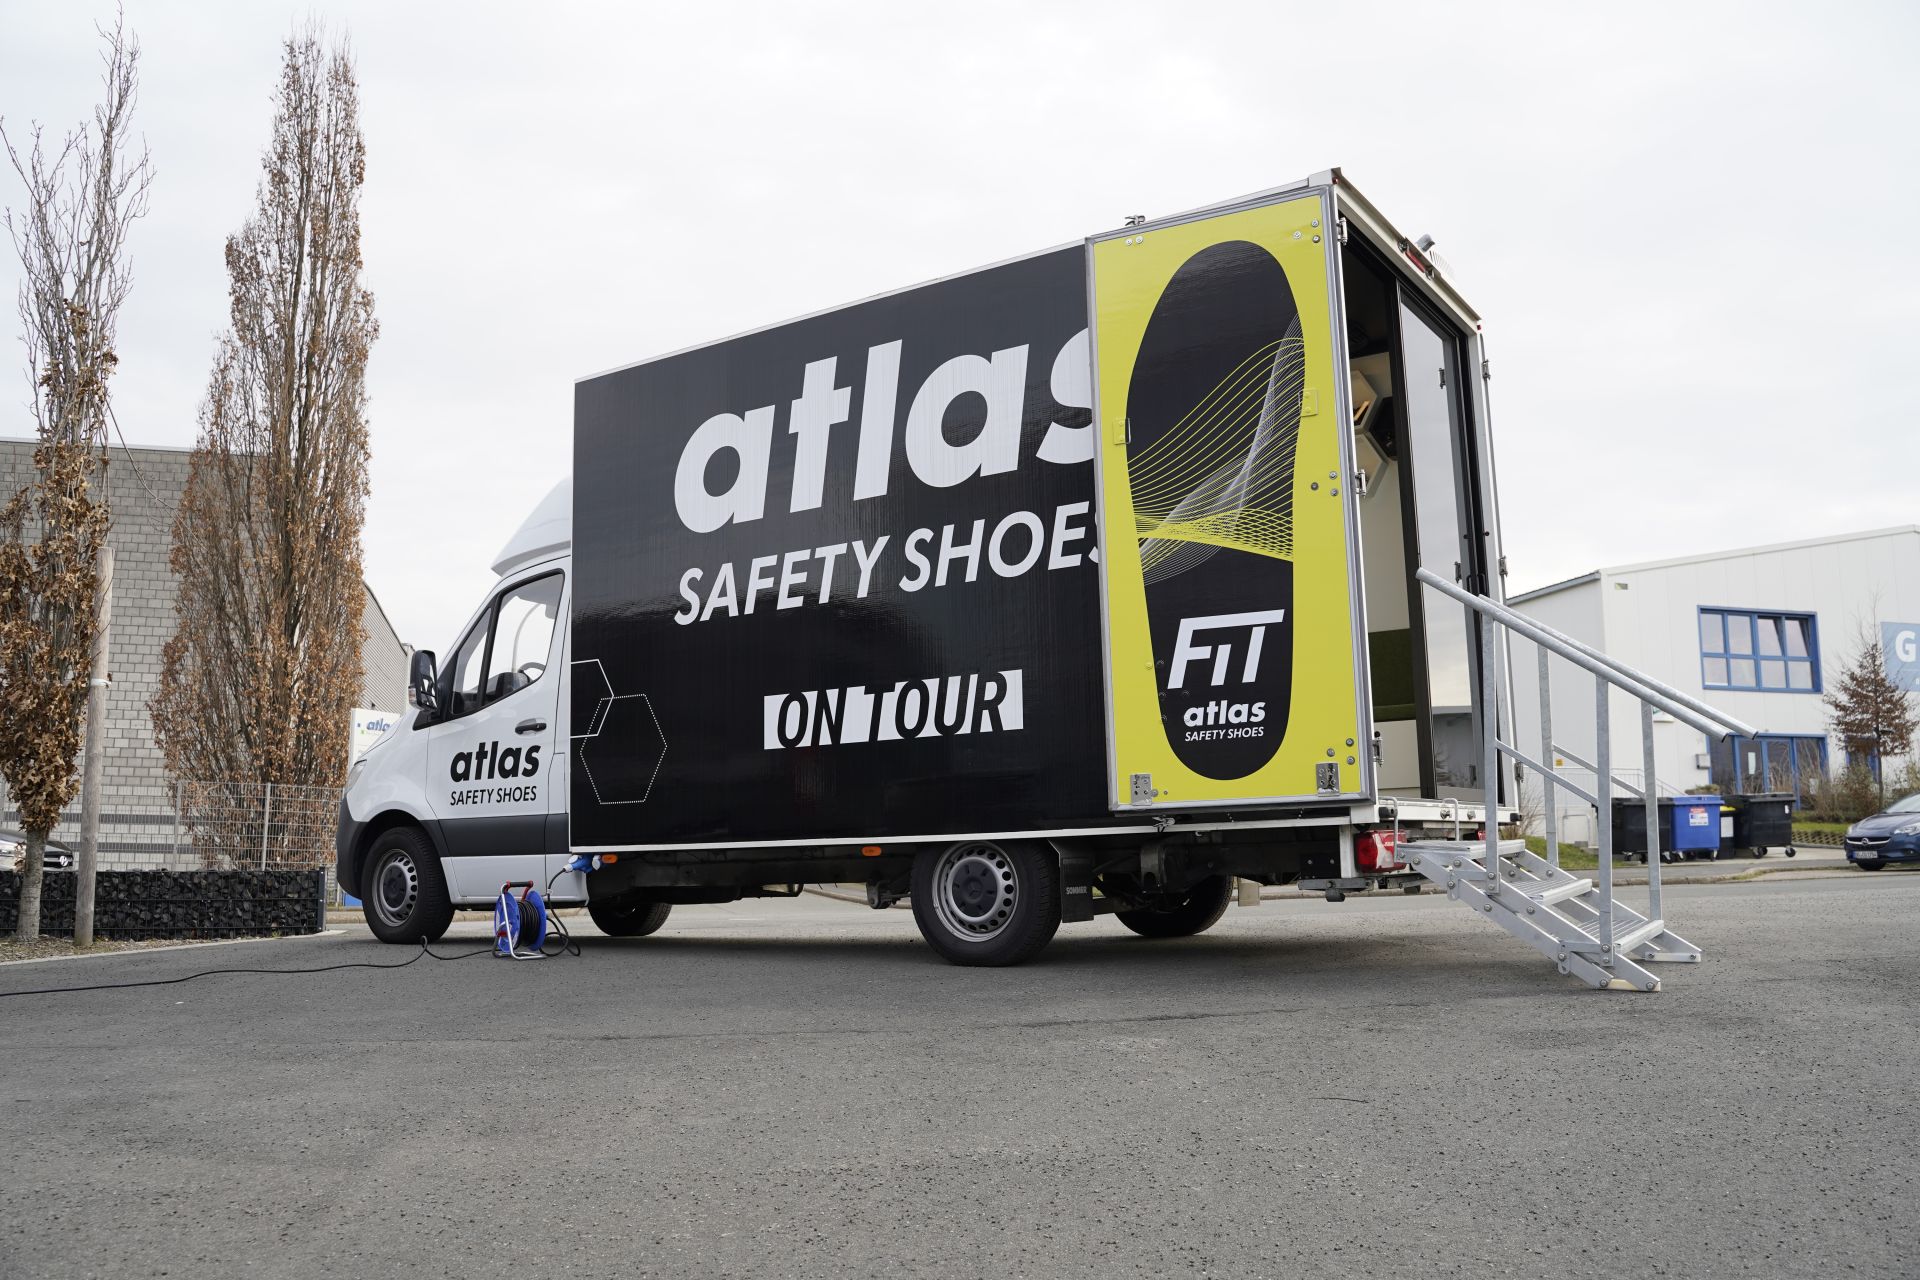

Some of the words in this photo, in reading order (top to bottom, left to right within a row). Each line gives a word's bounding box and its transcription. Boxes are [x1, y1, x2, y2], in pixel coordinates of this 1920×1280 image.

[673, 535, 891, 626] SAFETY
[898, 500, 1100, 593] SHOE
[1167, 609, 1285, 690] FIT
[367, 718, 391, 731] atla
[777, 687, 846, 749] ON
[863, 671, 1008, 740] TOUR
[1183, 700, 1266, 727] atlas
[1184, 729, 1226, 742] SAFETY
[1227, 726, 1264, 739] SHOES
[450, 740, 542, 783] atlas
[450, 788, 495, 806] SAFETY
[495, 785, 537, 804] SHOES
